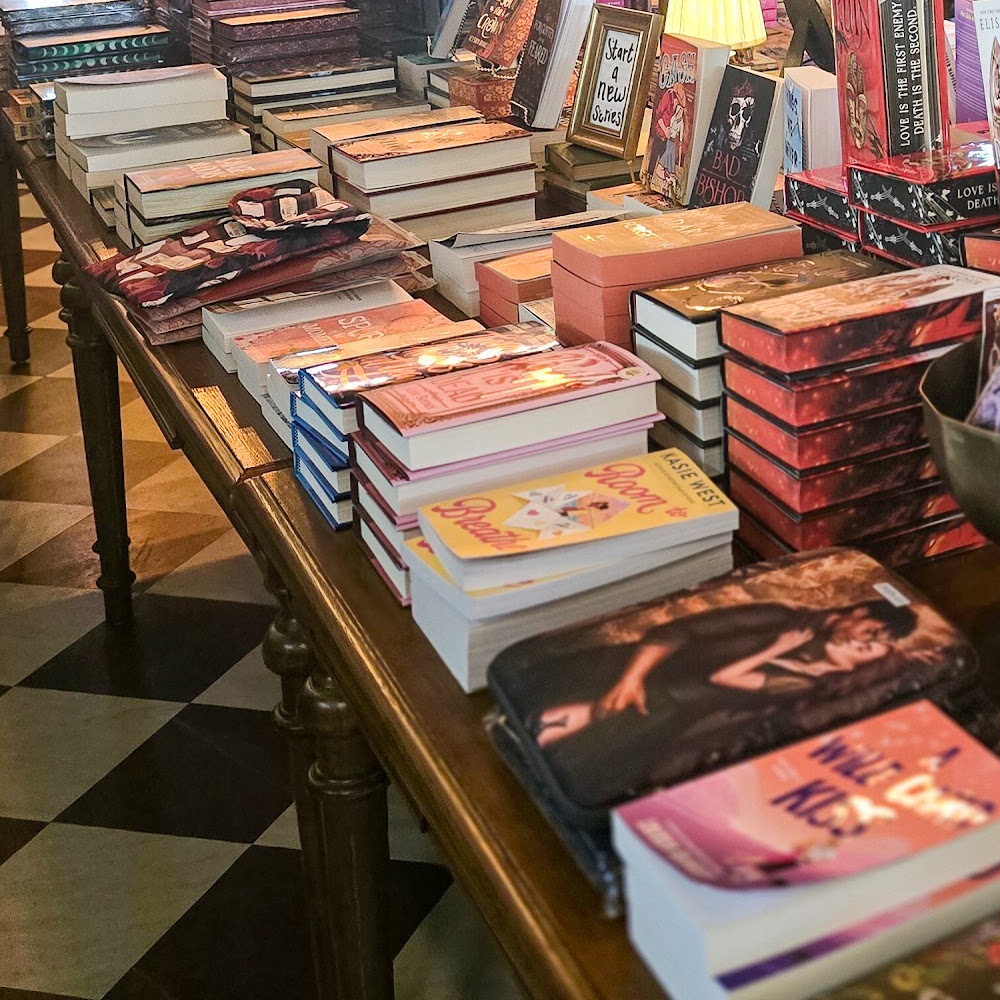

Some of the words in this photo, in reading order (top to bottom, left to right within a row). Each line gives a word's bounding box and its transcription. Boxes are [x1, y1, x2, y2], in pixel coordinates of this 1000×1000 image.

[477, 13, 504, 39] CROWN
[890, 1, 904, 38] ENEMY
[606, 37, 634, 63] Start
[895, 43, 906, 75] FIRST
[612, 66, 618, 83] a
[909, 65, 922, 87] THE
[598, 81, 626, 102] new
[897, 79, 908, 97] THE
[912, 89, 922, 101] IS
[592, 105, 621, 126] Series
[899, 103, 909, 114] IS
[913, 104, 925, 135] DEATH
[899, 118, 910, 146] LOVE
[712, 149, 740, 180] BAD
[957, 186, 985, 199] LOVE
[987, 182, 998, 193] IS
[584, 462, 655, 514] Room
[664, 501, 689, 519] to
[661, 451, 700, 488] KASIE
[689, 480, 727, 507] WEST
